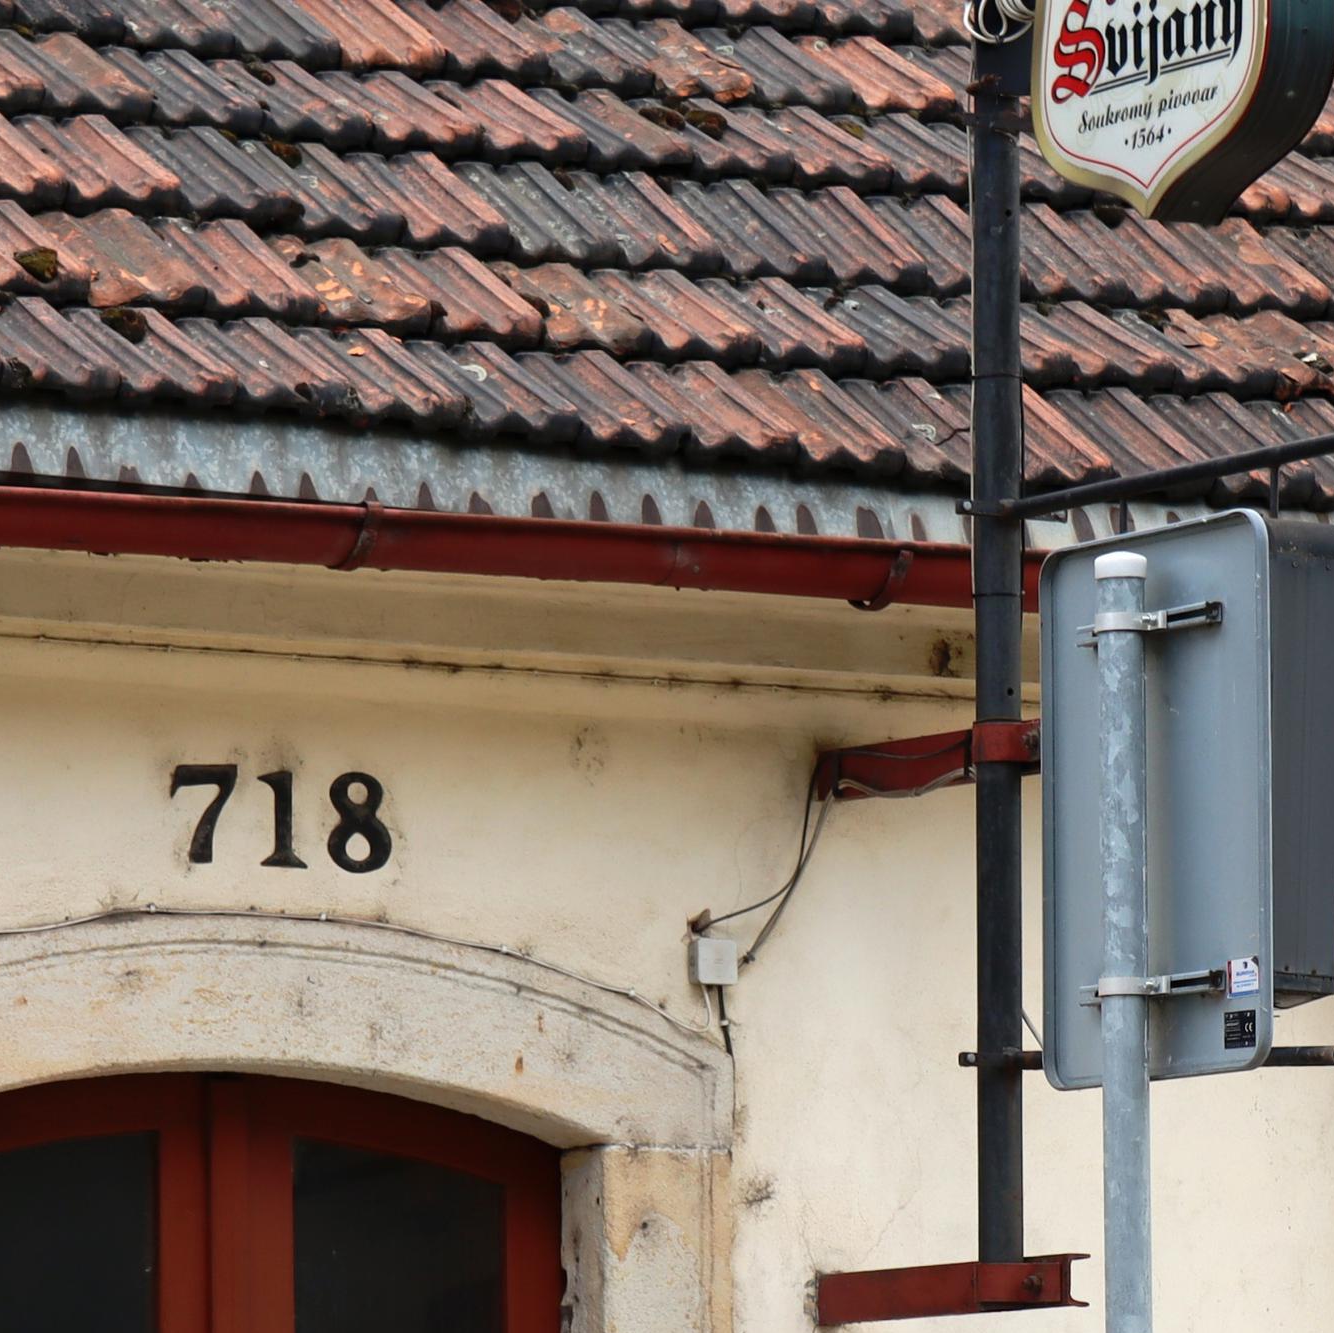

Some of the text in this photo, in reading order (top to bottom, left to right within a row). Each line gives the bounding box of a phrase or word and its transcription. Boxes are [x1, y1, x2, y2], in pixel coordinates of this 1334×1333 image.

[1051, 0, 1243, 104] Svijany
[1078, 86, 1218, 134] Soukromý pivovar
[170, 764, 392, 874] 718
